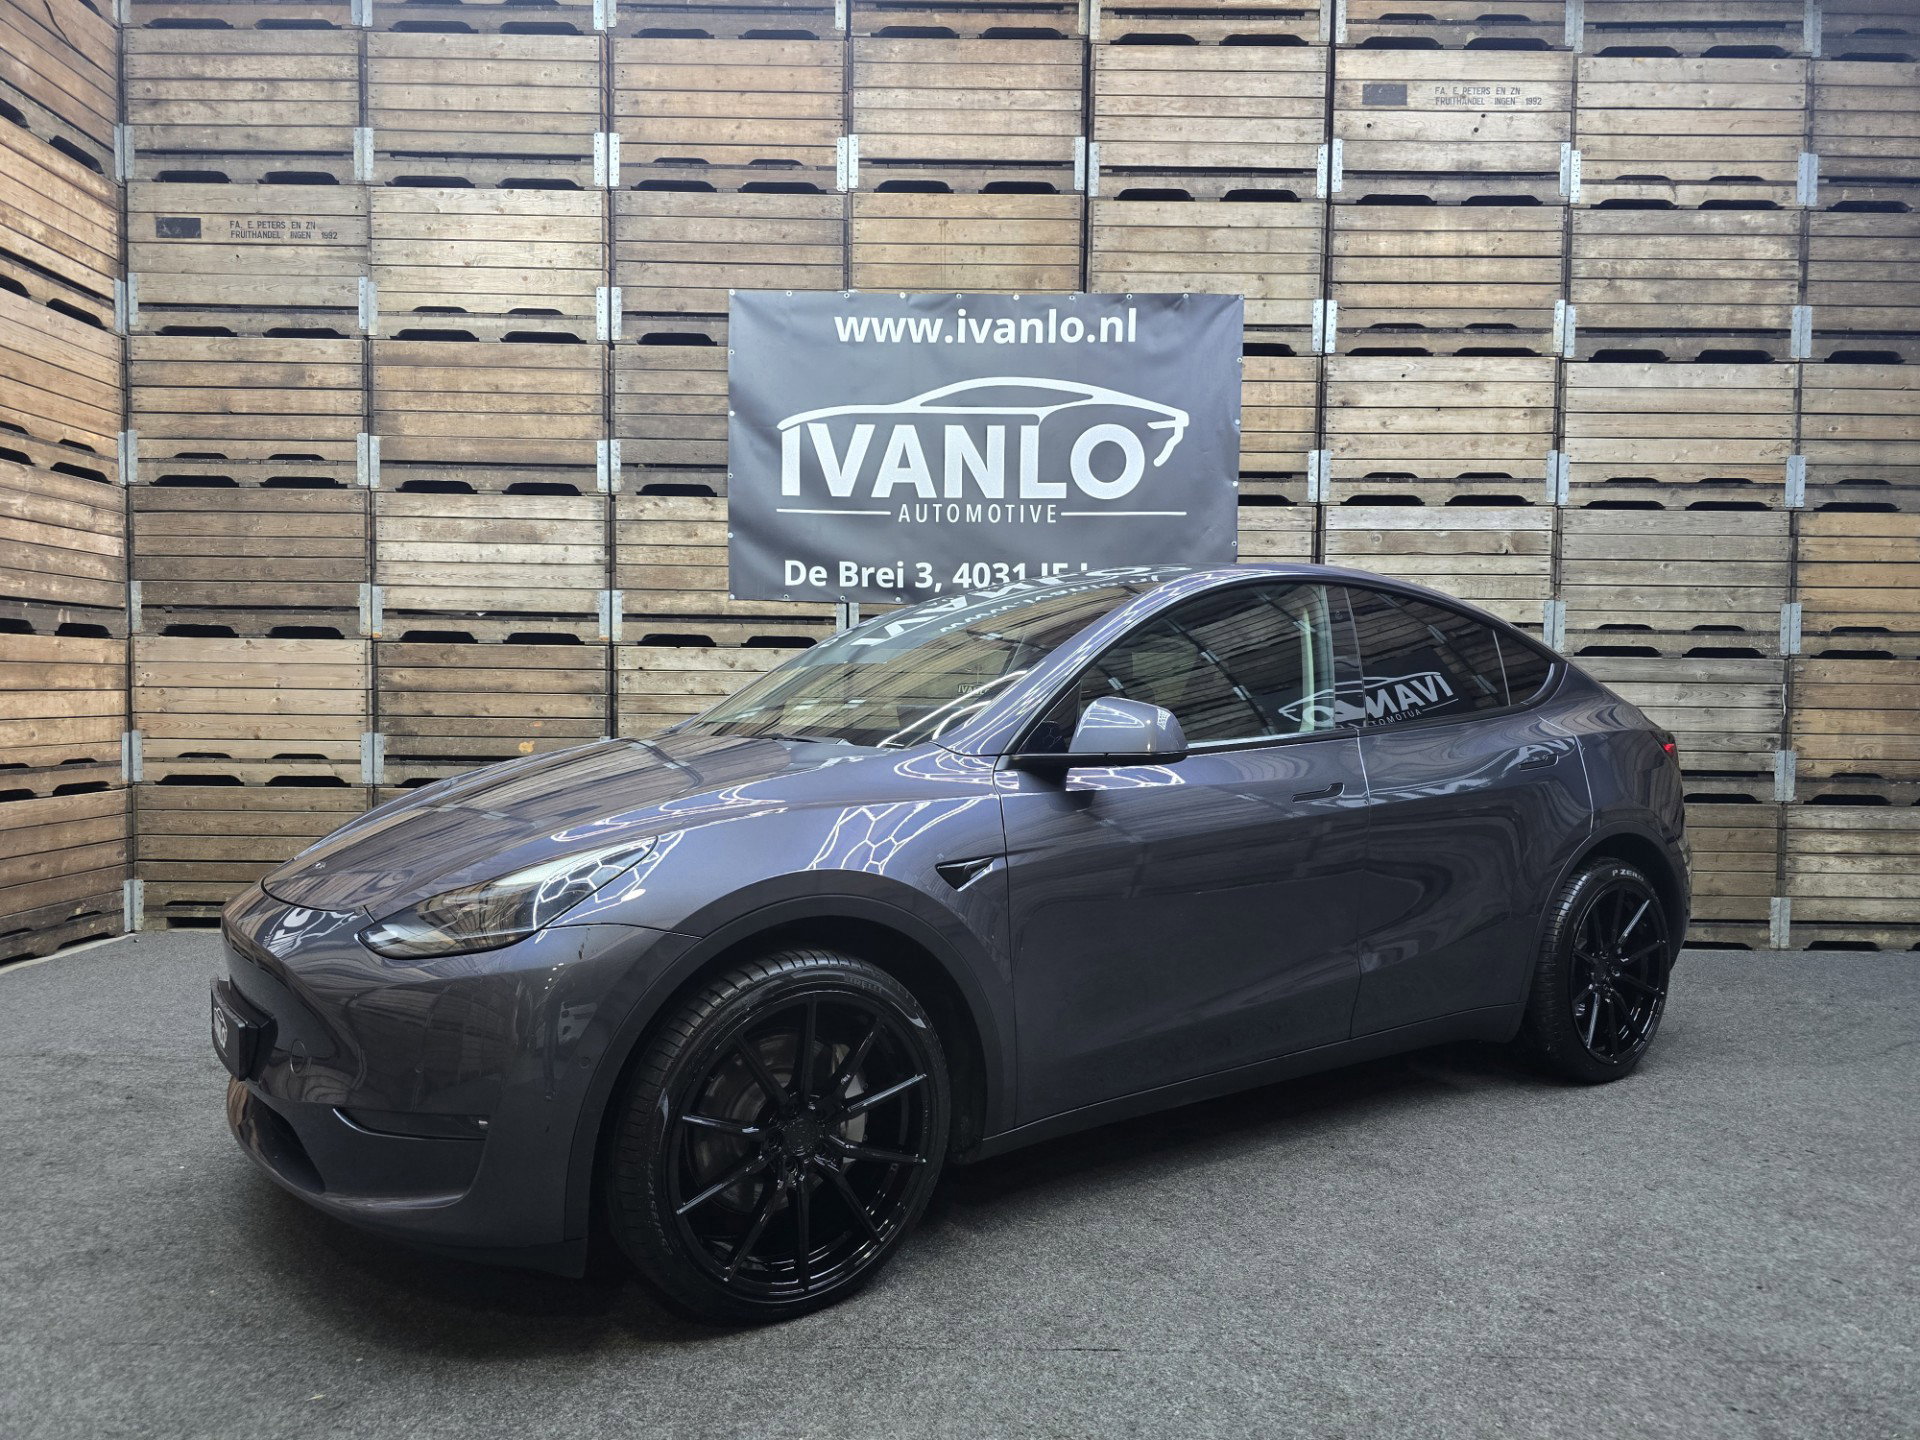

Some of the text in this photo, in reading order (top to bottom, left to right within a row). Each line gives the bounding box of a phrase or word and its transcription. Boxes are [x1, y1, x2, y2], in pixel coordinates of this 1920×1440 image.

[1462, 86, 1491, 95] PETERS
[1495, 86, 1506, 95] EN
[1510, 86, 1521, 95] ZN
[1435, 96, 1543, 106] FRUITHANDEL INGEN 1992
[256, 220, 286, 230] PETERS
[291, 221, 301, 230] EN
[230, 230, 281, 240] FRUITHANDEL
[289, 231, 312, 240] INGEN
[834, 308, 1138, 345] www.ivanlo.nl
[781, 423, 1146, 500] IVANLO
[898, 504, 1058, 524] AUTOMOTIVE
[784, 560, 829, 588] De
[839, 561, 905, 589] Brei
[915, 562, 943, 595] 3,
[952, 562, 1027, 588] 4031
